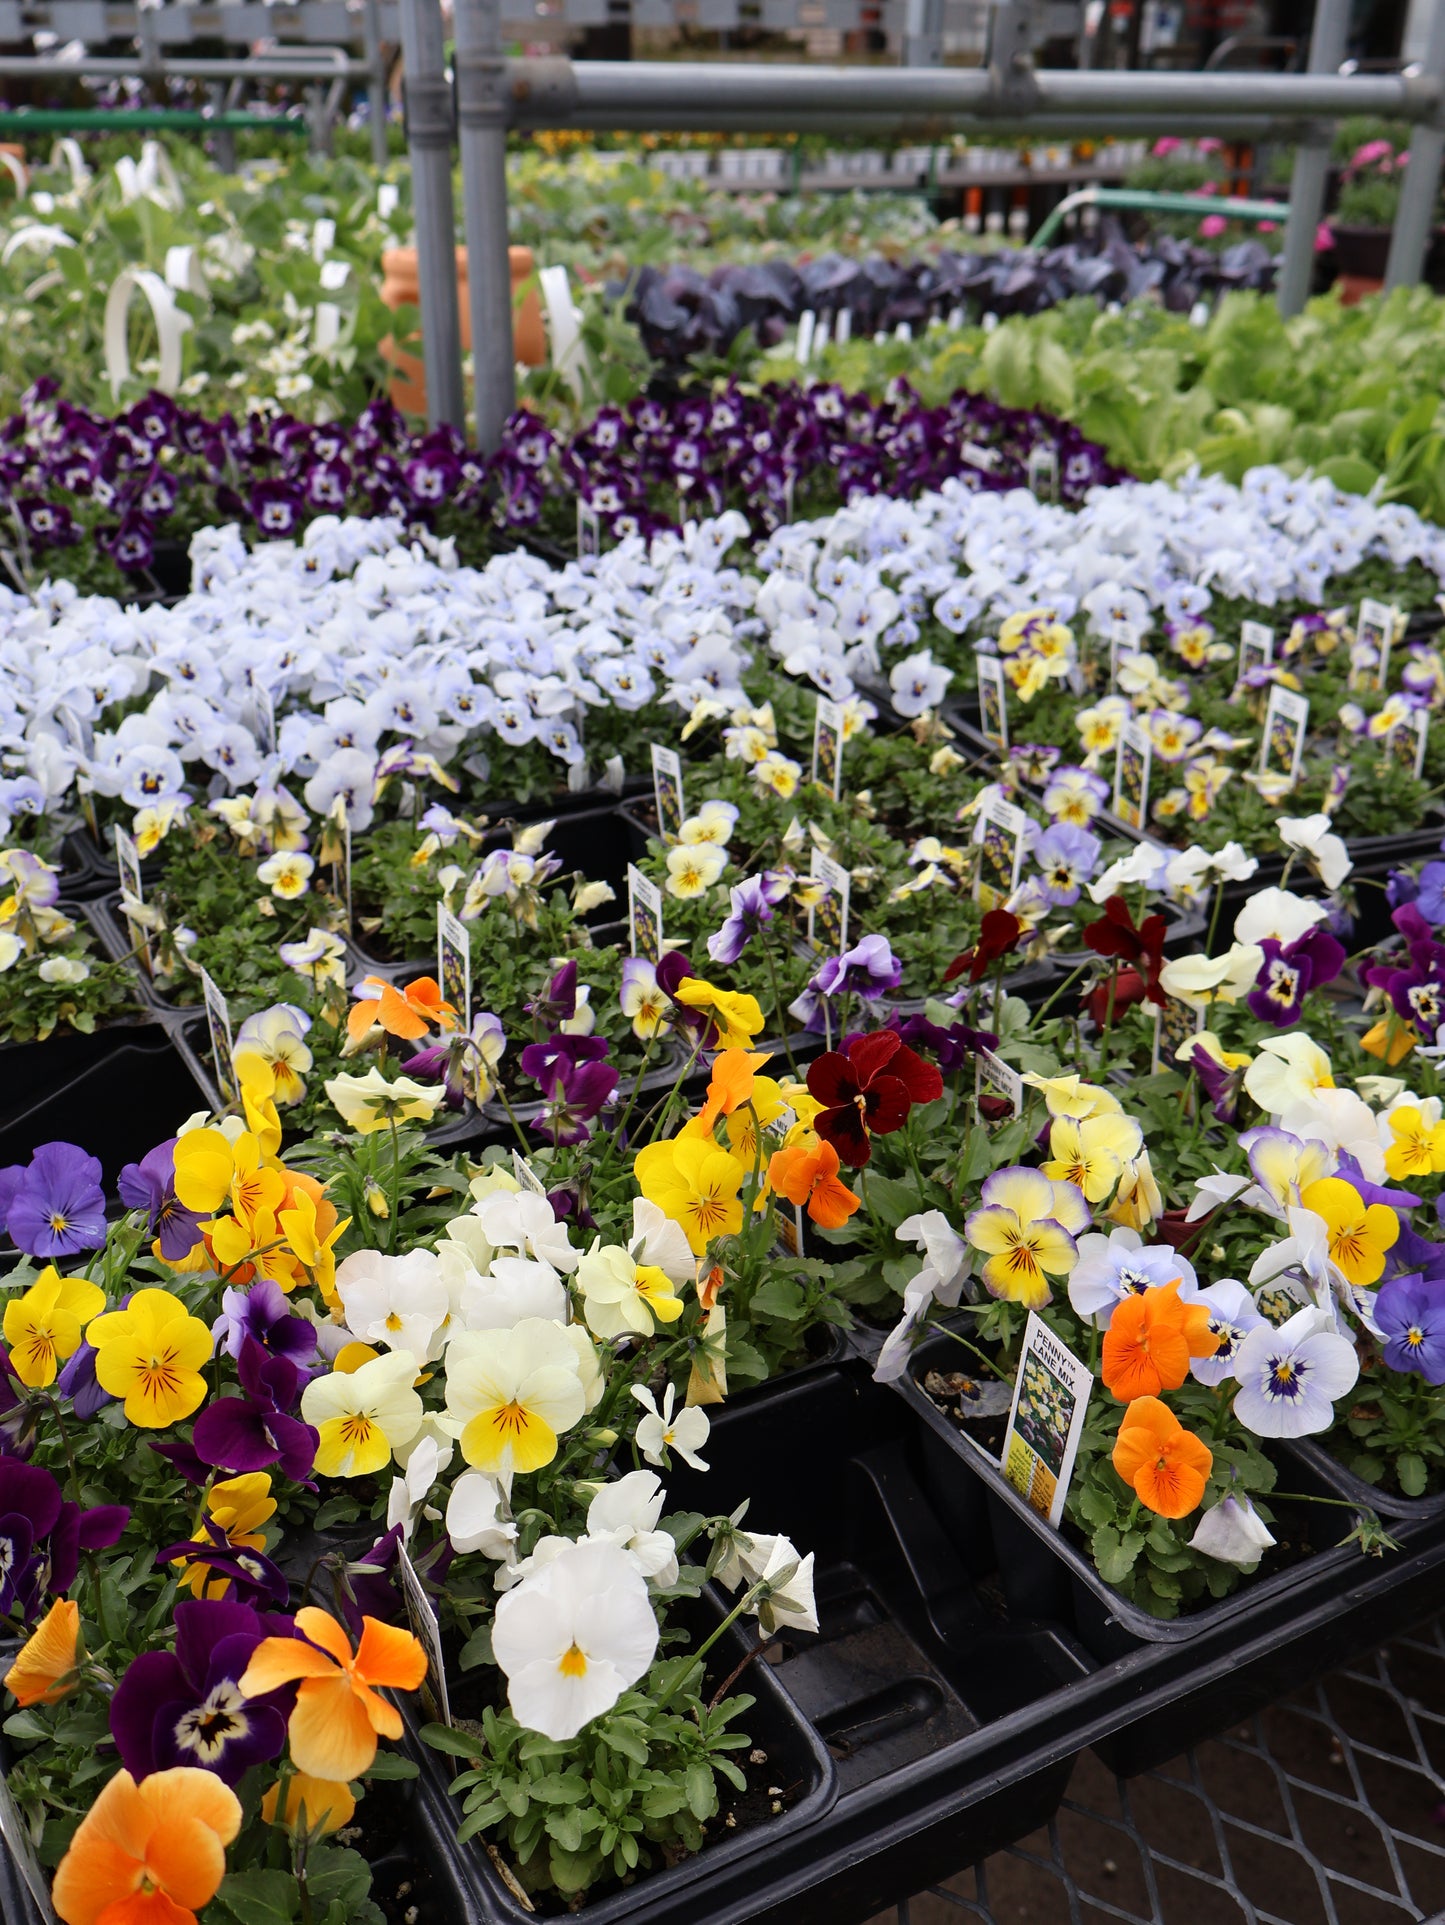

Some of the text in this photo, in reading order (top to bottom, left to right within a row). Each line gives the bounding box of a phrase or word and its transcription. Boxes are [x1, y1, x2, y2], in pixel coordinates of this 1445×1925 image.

[1033, 1339, 1076, 1391] LANE MIX
[1024, 1446, 1046, 1475] VIOLA
